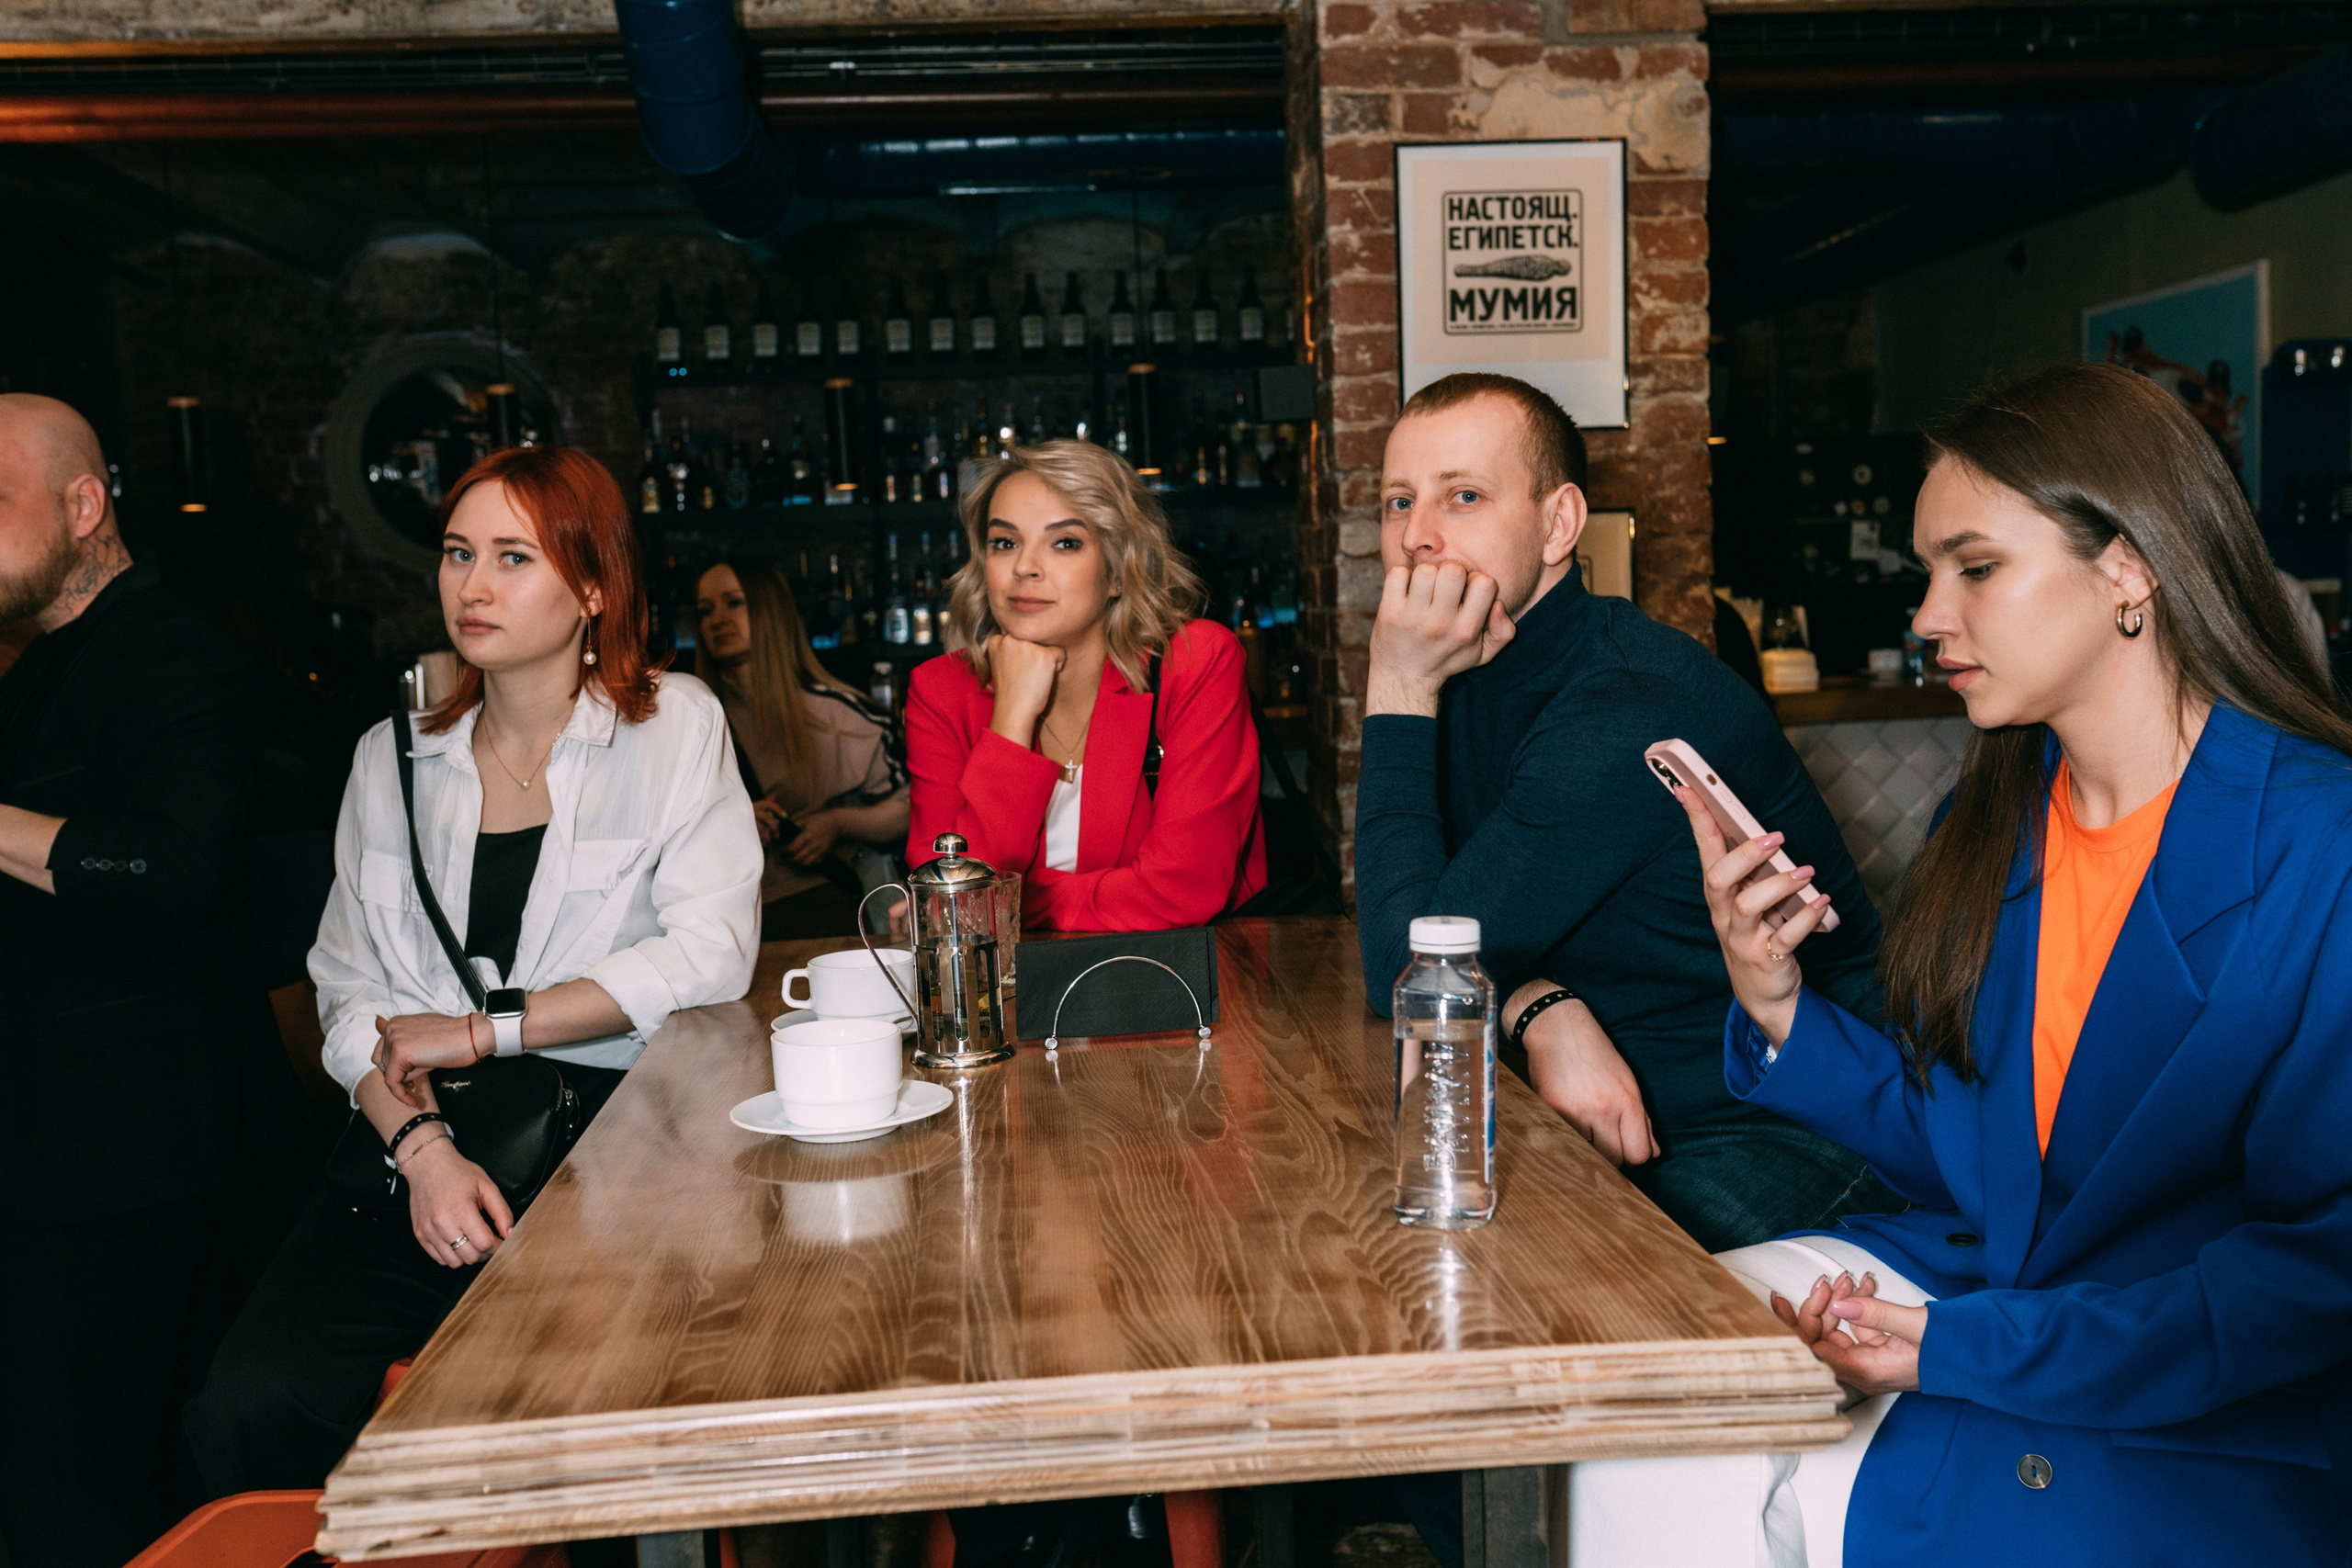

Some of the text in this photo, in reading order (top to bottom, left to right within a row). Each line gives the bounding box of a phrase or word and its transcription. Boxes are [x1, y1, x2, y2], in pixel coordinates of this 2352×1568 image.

[1448, 195, 1579, 222] НАСТОЯЩ.
[1448, 224, 1579, 250] ЕГИПЕТСК.
[1449, 287, 1577, 321] МУМИЯ
